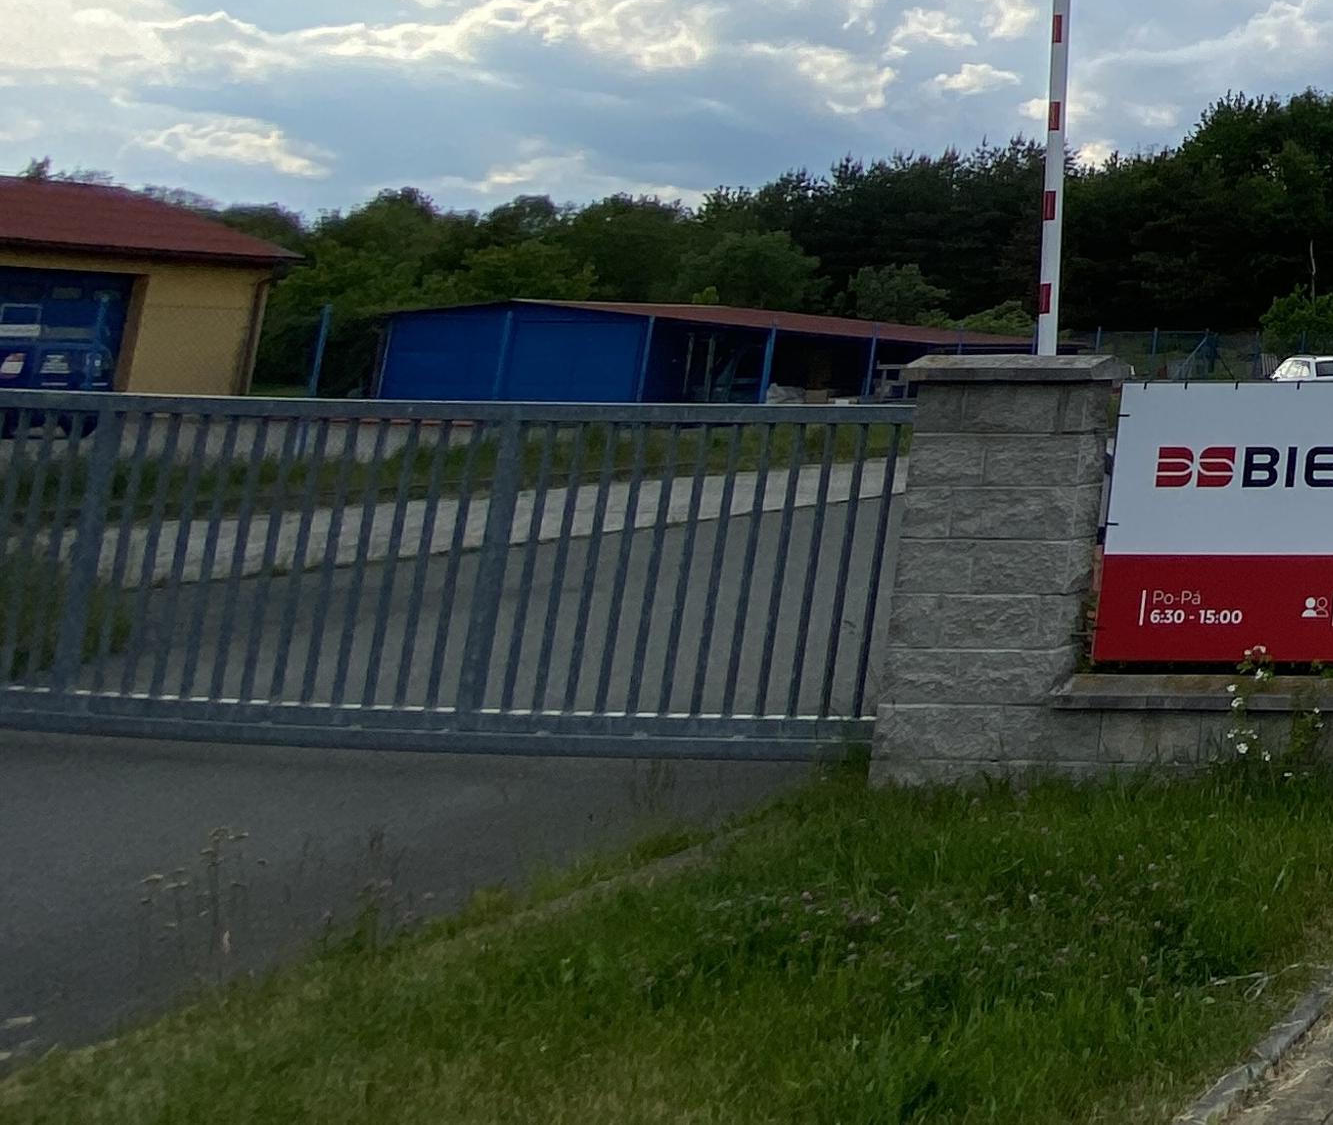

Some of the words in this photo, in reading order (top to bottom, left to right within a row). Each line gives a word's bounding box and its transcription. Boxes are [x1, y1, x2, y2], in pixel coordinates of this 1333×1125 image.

[1153, 589, 1201, 605] Po-Pá
[1150, 609, 1185, 624] 6:30
[1199, 609, 1243, 624] 15:00
